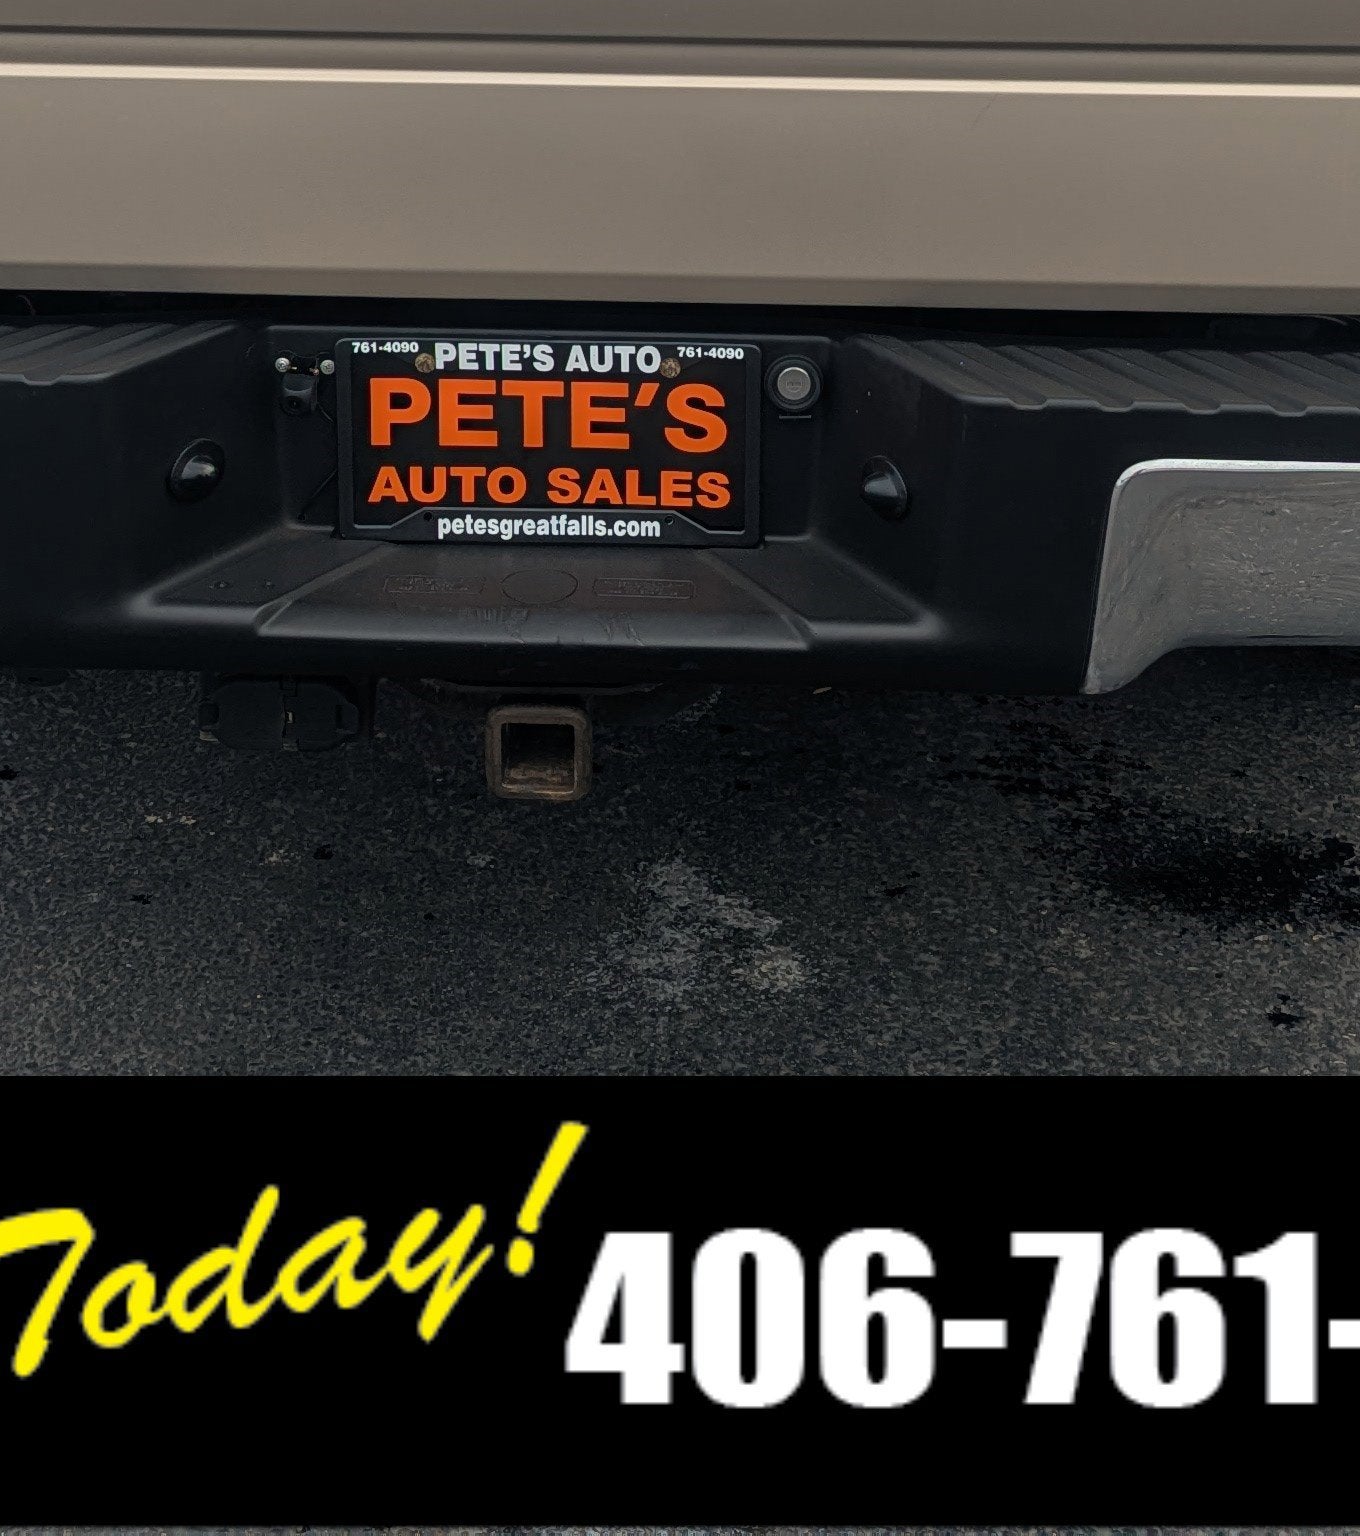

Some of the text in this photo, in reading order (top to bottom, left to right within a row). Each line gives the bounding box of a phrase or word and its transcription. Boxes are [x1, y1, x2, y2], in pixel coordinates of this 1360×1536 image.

[352, 342, 419, 354] 761-4090
[435, 343, 661, 374] PETE'S AUTO
[677, 346, 744, 360] 761-4090
[370, 377, 728, 453] PETE'S
[368, 466, 731, 509] AUTO SALES
[437, 515, 661, 540] petesgreatfalls.com
